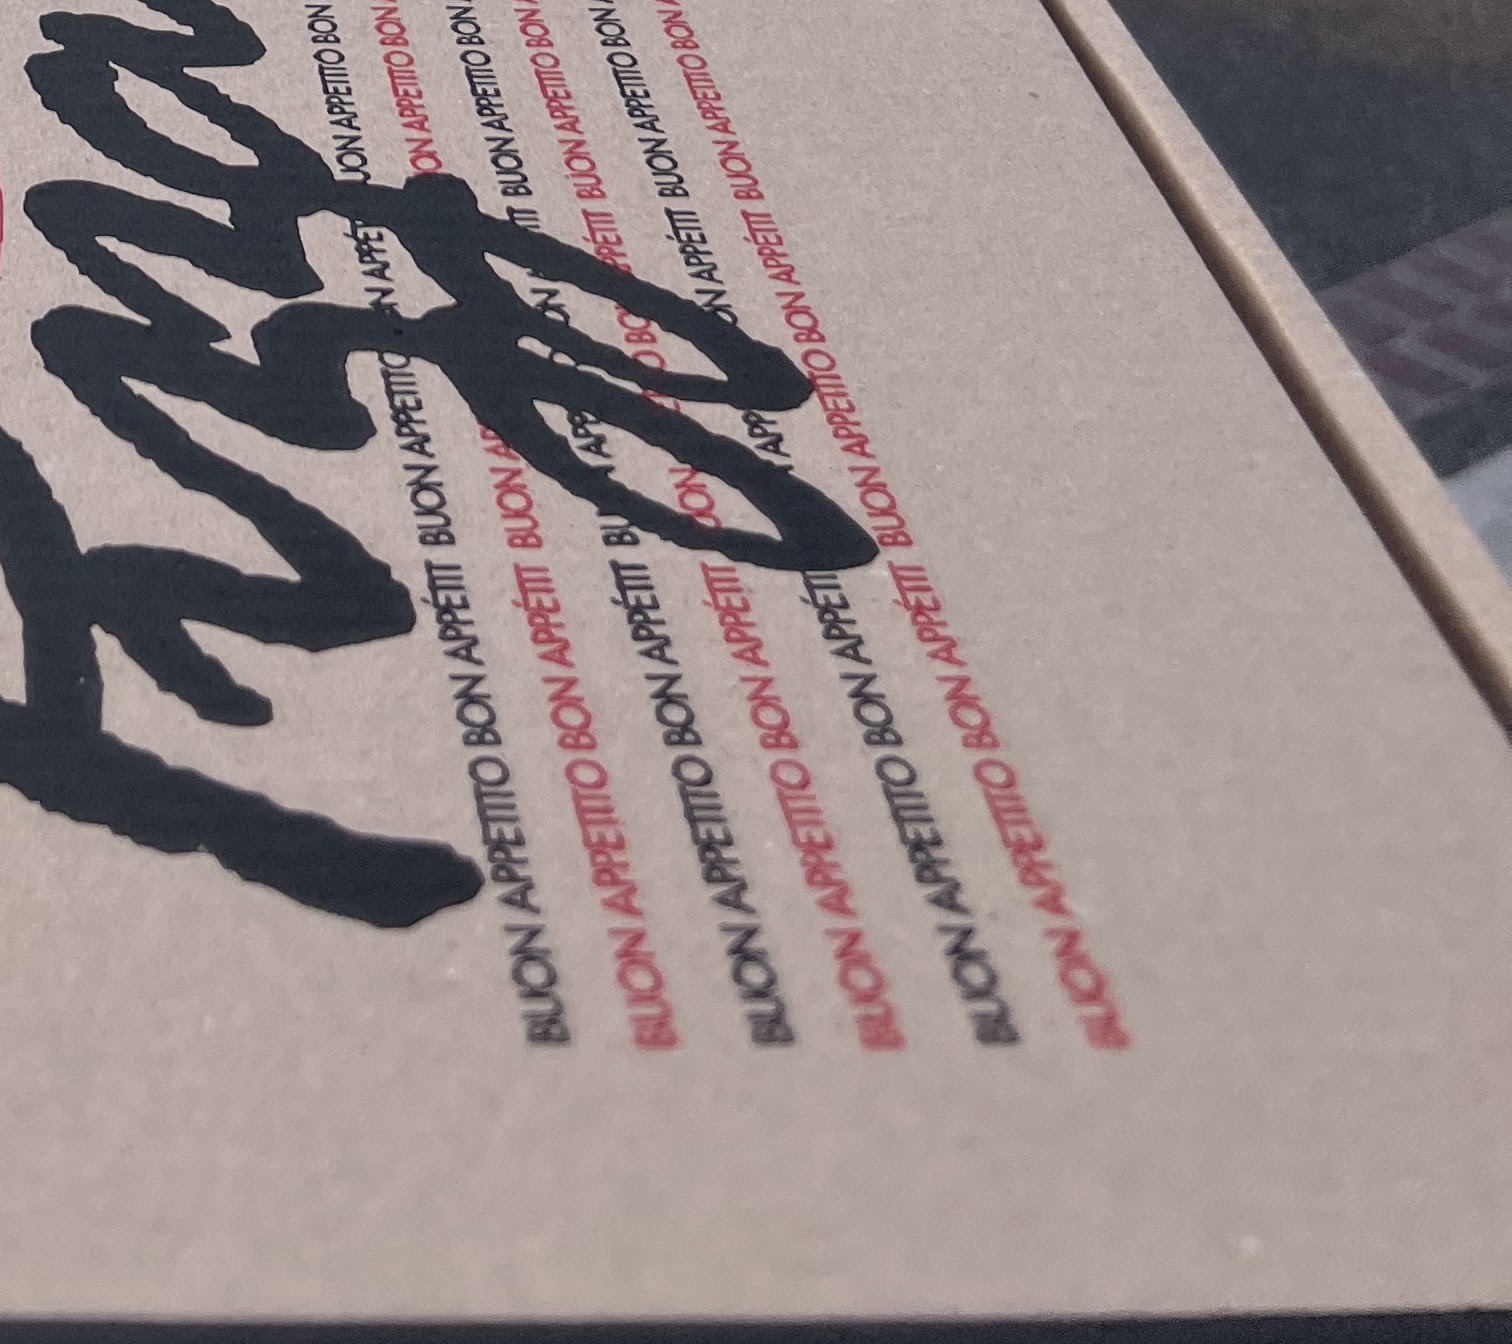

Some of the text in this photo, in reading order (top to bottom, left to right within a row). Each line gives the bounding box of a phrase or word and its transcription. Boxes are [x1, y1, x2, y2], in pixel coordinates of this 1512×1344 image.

[304, 3, 341, 43] BON
[371, 4, 412, 46] BON
[445, 5, 486, 44] BON
[513, 6, 555, 48] BON
[587, 6, 631, 47] BON
[656, 9, 701, 50] BON
[313, 48, 361, 130] APPETITO
[382, 49, 435, 132] APPETITO
[458, 49, 513, 132] APPETITO
[528, 51, 585, 134] APPETITO
[604, 51, 664, 133] APPETITO
[674, 53, 738, 135] APPETITO
[483, 135, 533, 196] BUON
[557, 138, 608, 199] BUON
[636, 136, 689, 197] BUON
[710, 139, 766, 200] BUON
[662, 206, 723, 283] APPÉTIT
[739, 210, 803, 285] APPÉTIT
[773, 290, 828, 343] BON
[796, 348, 877, 459] APPETITO
[401, 462, 456, 546] BUON
[486, 465, 547, 549] BUON
[845, 465, 915, 547] BUON
[421, 560, 483, 666] APPÉTIT
[511, 562, 578, 667] APPÉTIT
[608, 558, 678, 664] APPÉTIT
[697, 561, 770, 666] APPÉTIT
[884, 559, 966, 666] APPÉTIT
[446, 672, 502, 747] BON
[539, 675, 600, 750] BON
[641, 672, 703, 745] BON
[735, 674, 799, 749] BON
[837, 672, 904, 747] BON
[931, 675, 1002, 749] BON
[464, 755, 540, 913] APPETITO
[560, 757, 645, 917] APPETITO
[665, 754, 755, 914] APPETITO
[763, 758, 858, 917] APPETITO
[868, 754, 969, 913] APPETITO
[966, 758, 1074, 917] APPETITO
